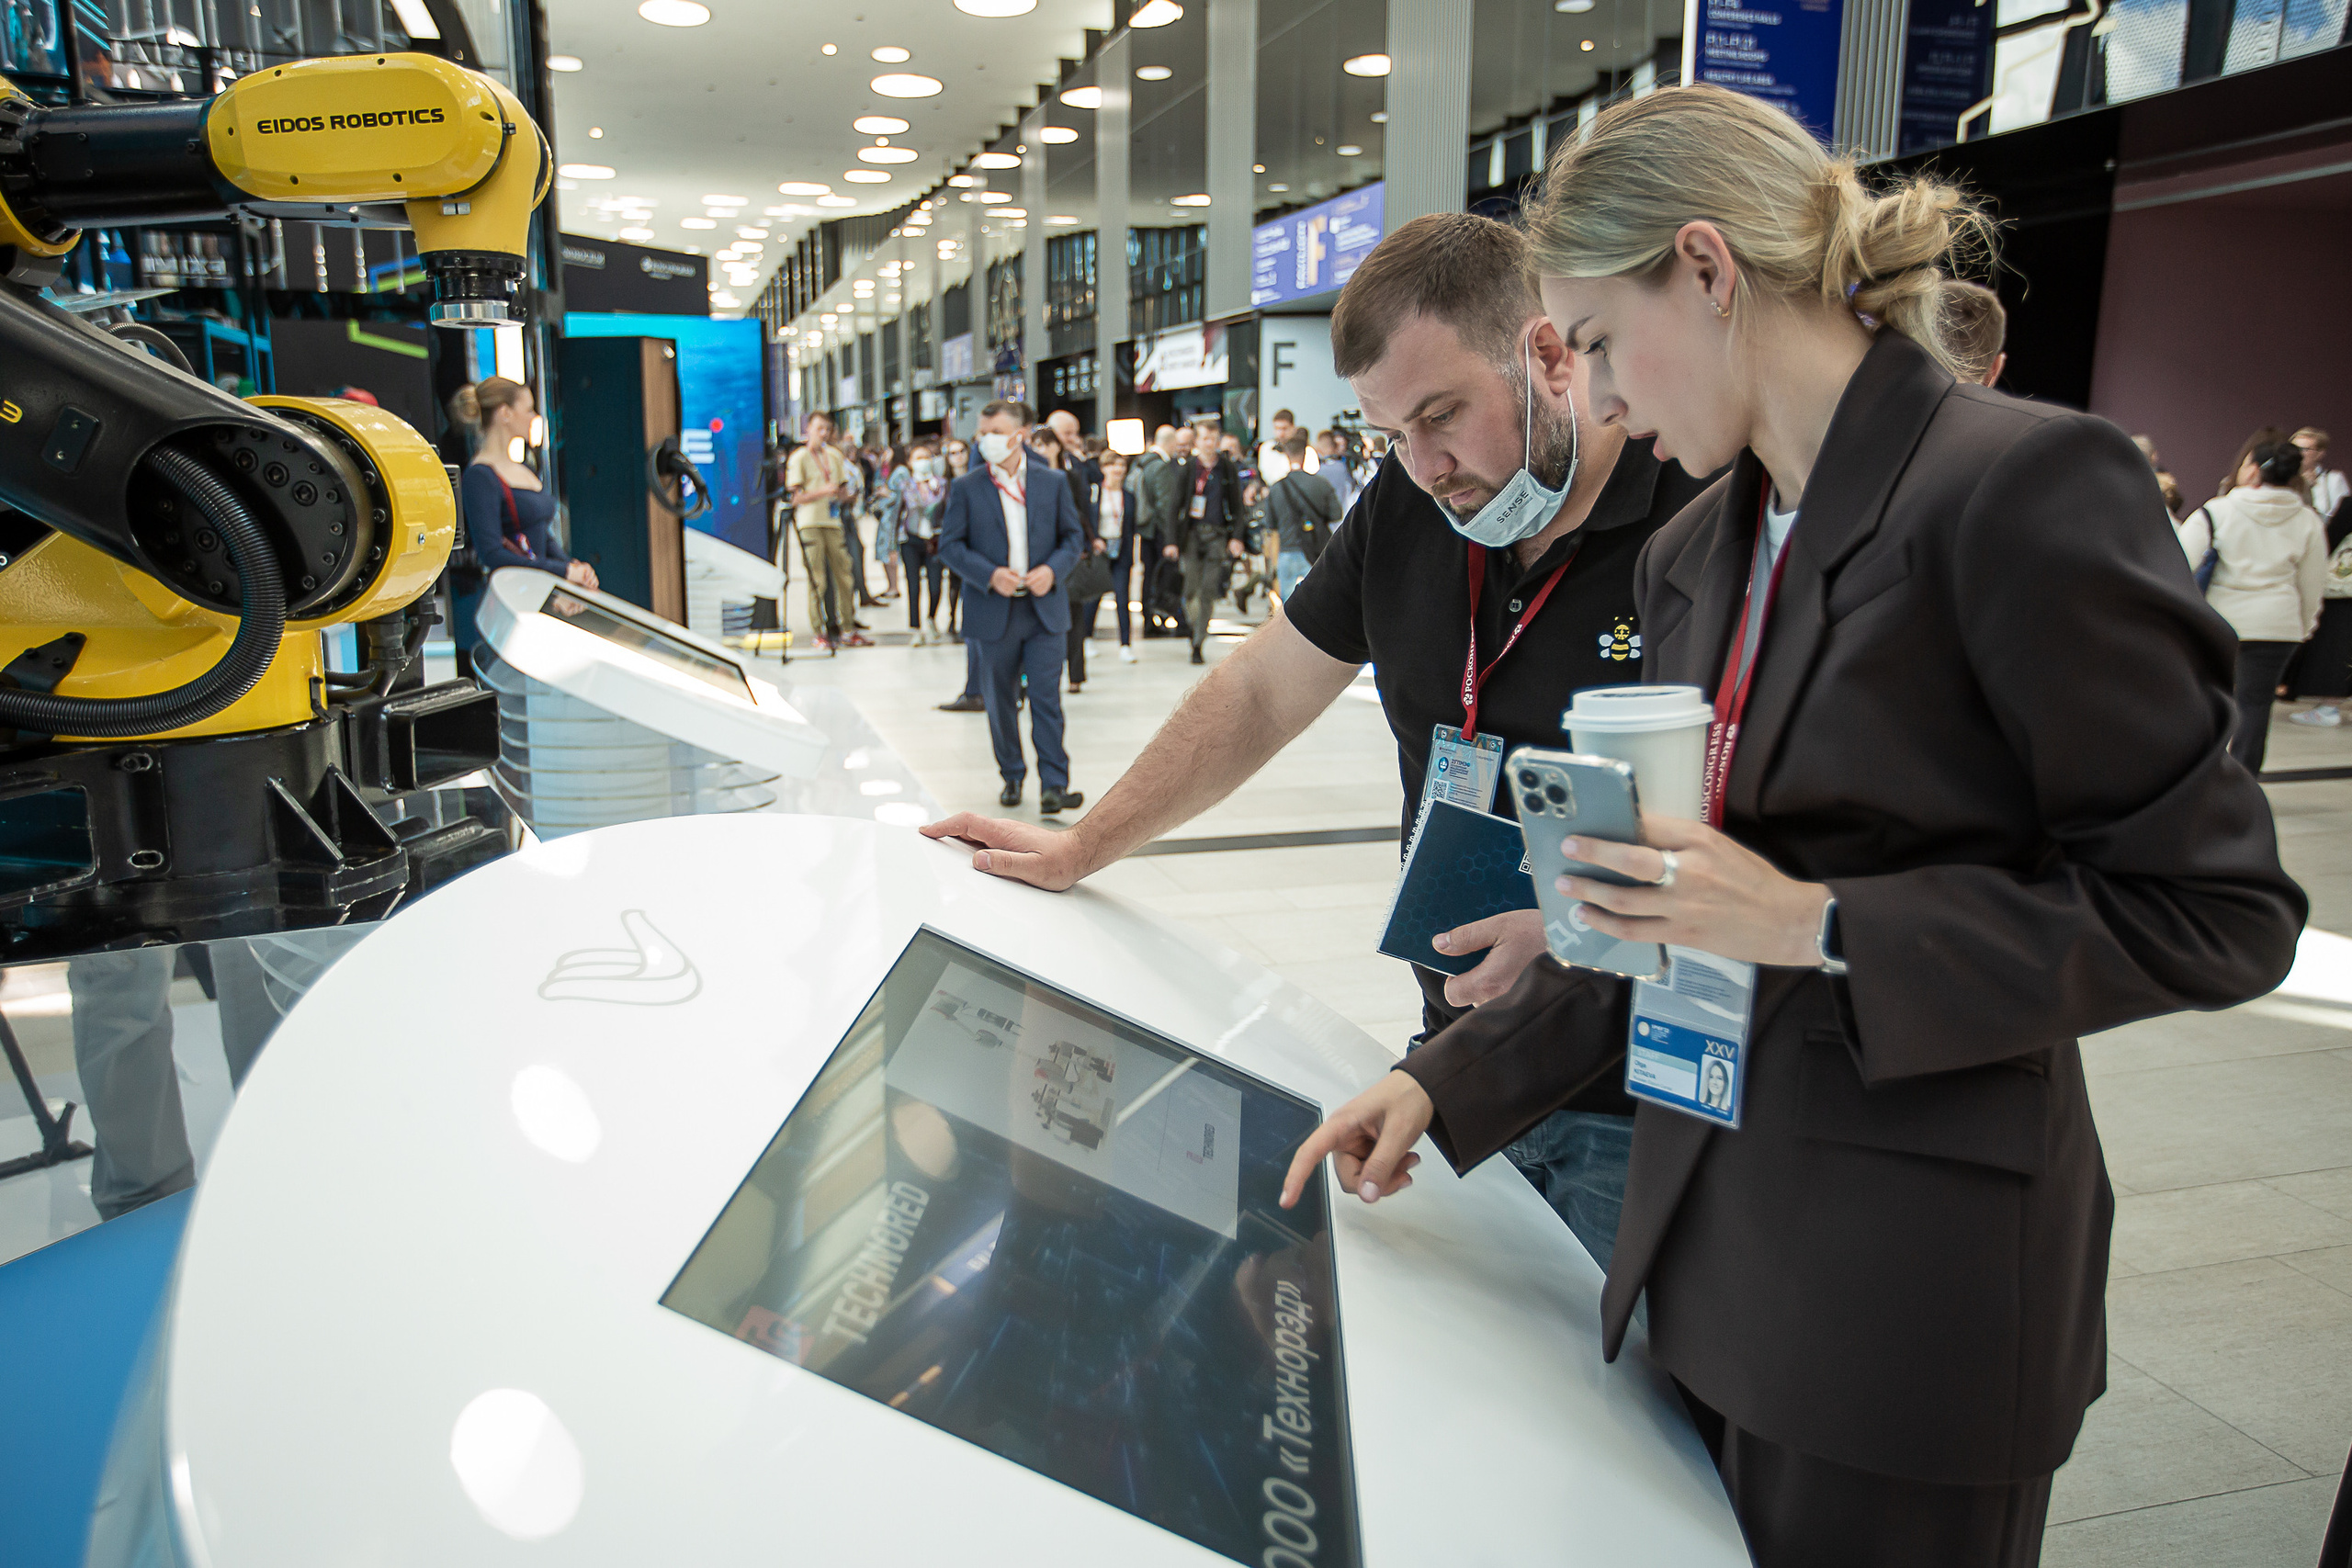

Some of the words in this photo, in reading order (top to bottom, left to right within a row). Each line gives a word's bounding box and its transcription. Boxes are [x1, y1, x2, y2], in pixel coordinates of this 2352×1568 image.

[256, 116, 325, 134] EIDOS
[330, 107, 445, 130] ROBOTICS
[1272, 341, 1296, 387] F
[1496, 490, 1530, 525] SENSE
[1704, 1039, 1736, 1059] XXV
[821, 1179, 931, 1344] TECHNORED
[1263, 1280, 1320, 1474] «Технорэд»
